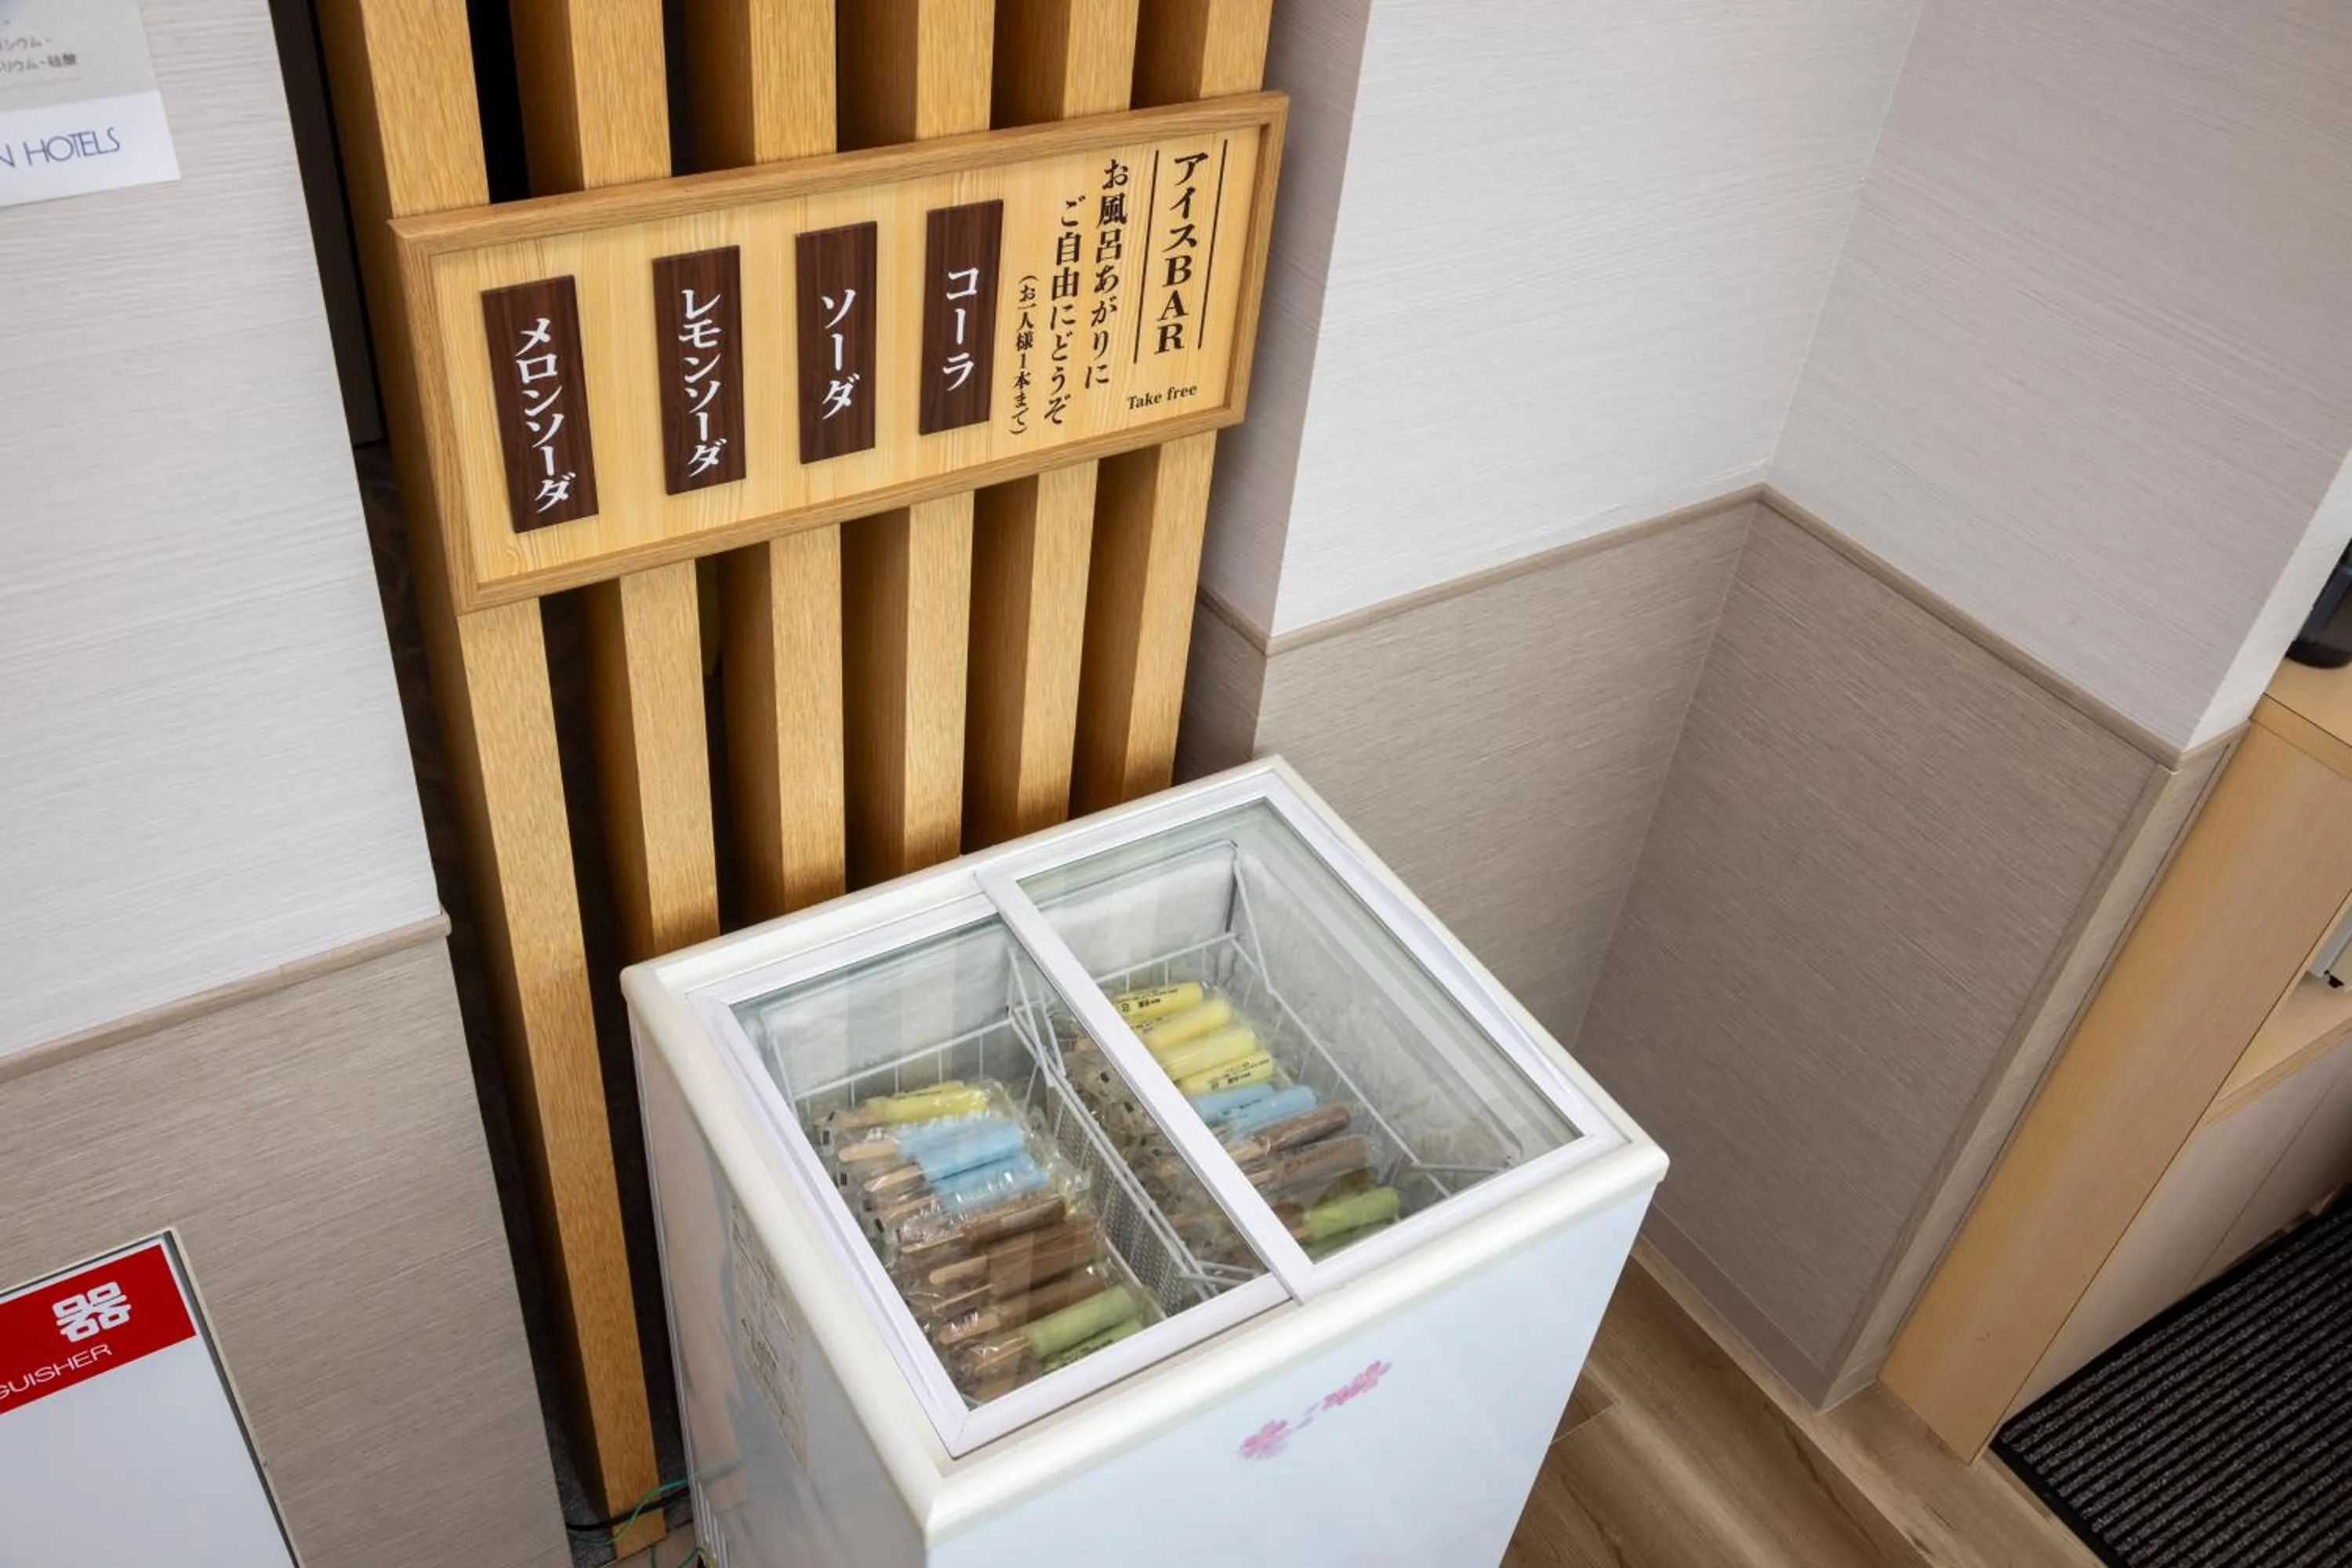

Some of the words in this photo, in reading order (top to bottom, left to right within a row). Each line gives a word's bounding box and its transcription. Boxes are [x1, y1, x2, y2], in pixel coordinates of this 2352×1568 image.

[24, 127, 120, 166] HOTELS
[942, 267, 978, 390] コーラ
[1044, 194, 1085, 423] ご自由にどうぞ
[1085, 159, 1128, 389] お風呂あがりに
[1154, 153, 1208, 354] アイスBAR
[516, 318, 575, 513] メロンソーダ
[679, 289, 727, 477] レモンソーダ
[822, 289, 859, 419] ソーダ
[1127, 392, 1162, 409] Take
[1167, 385, 1197, 401] free
[52, 1281, 131, 1343] 器
